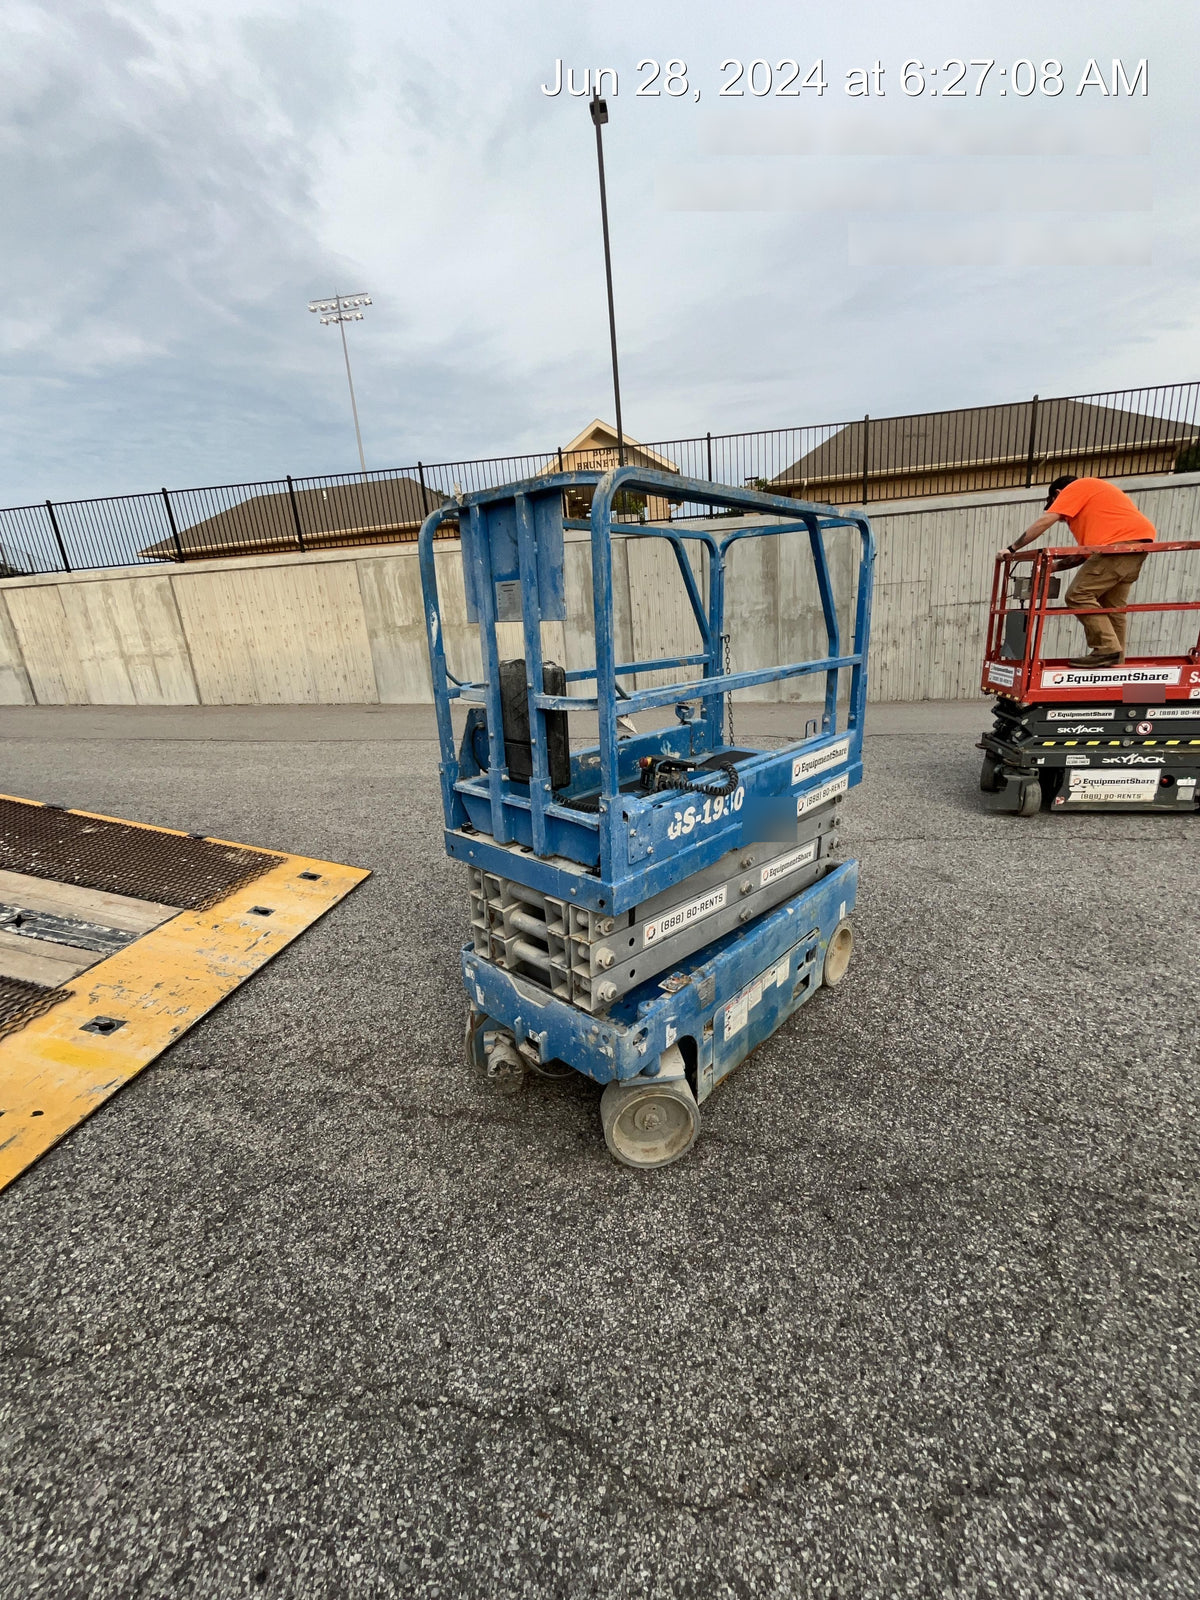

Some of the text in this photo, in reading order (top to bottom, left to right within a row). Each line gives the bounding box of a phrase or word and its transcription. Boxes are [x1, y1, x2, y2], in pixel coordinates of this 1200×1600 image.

[1066, 673, 1169, 684] EquipmentShare
[1057, 724, 1105, 734] SKYJACK
[801, 747, 848, 773] EquipmentShare
[1102, 753, 1166, 765] SKYJACK
[1083, 778, 1156, 787] EquipmentShare
[806, 778, 847, 807] (888) 80-RENTS
[769, 851, 812, 877] EquipmentShare
[660, 893, 724, 933] (888) 80-RENTS
